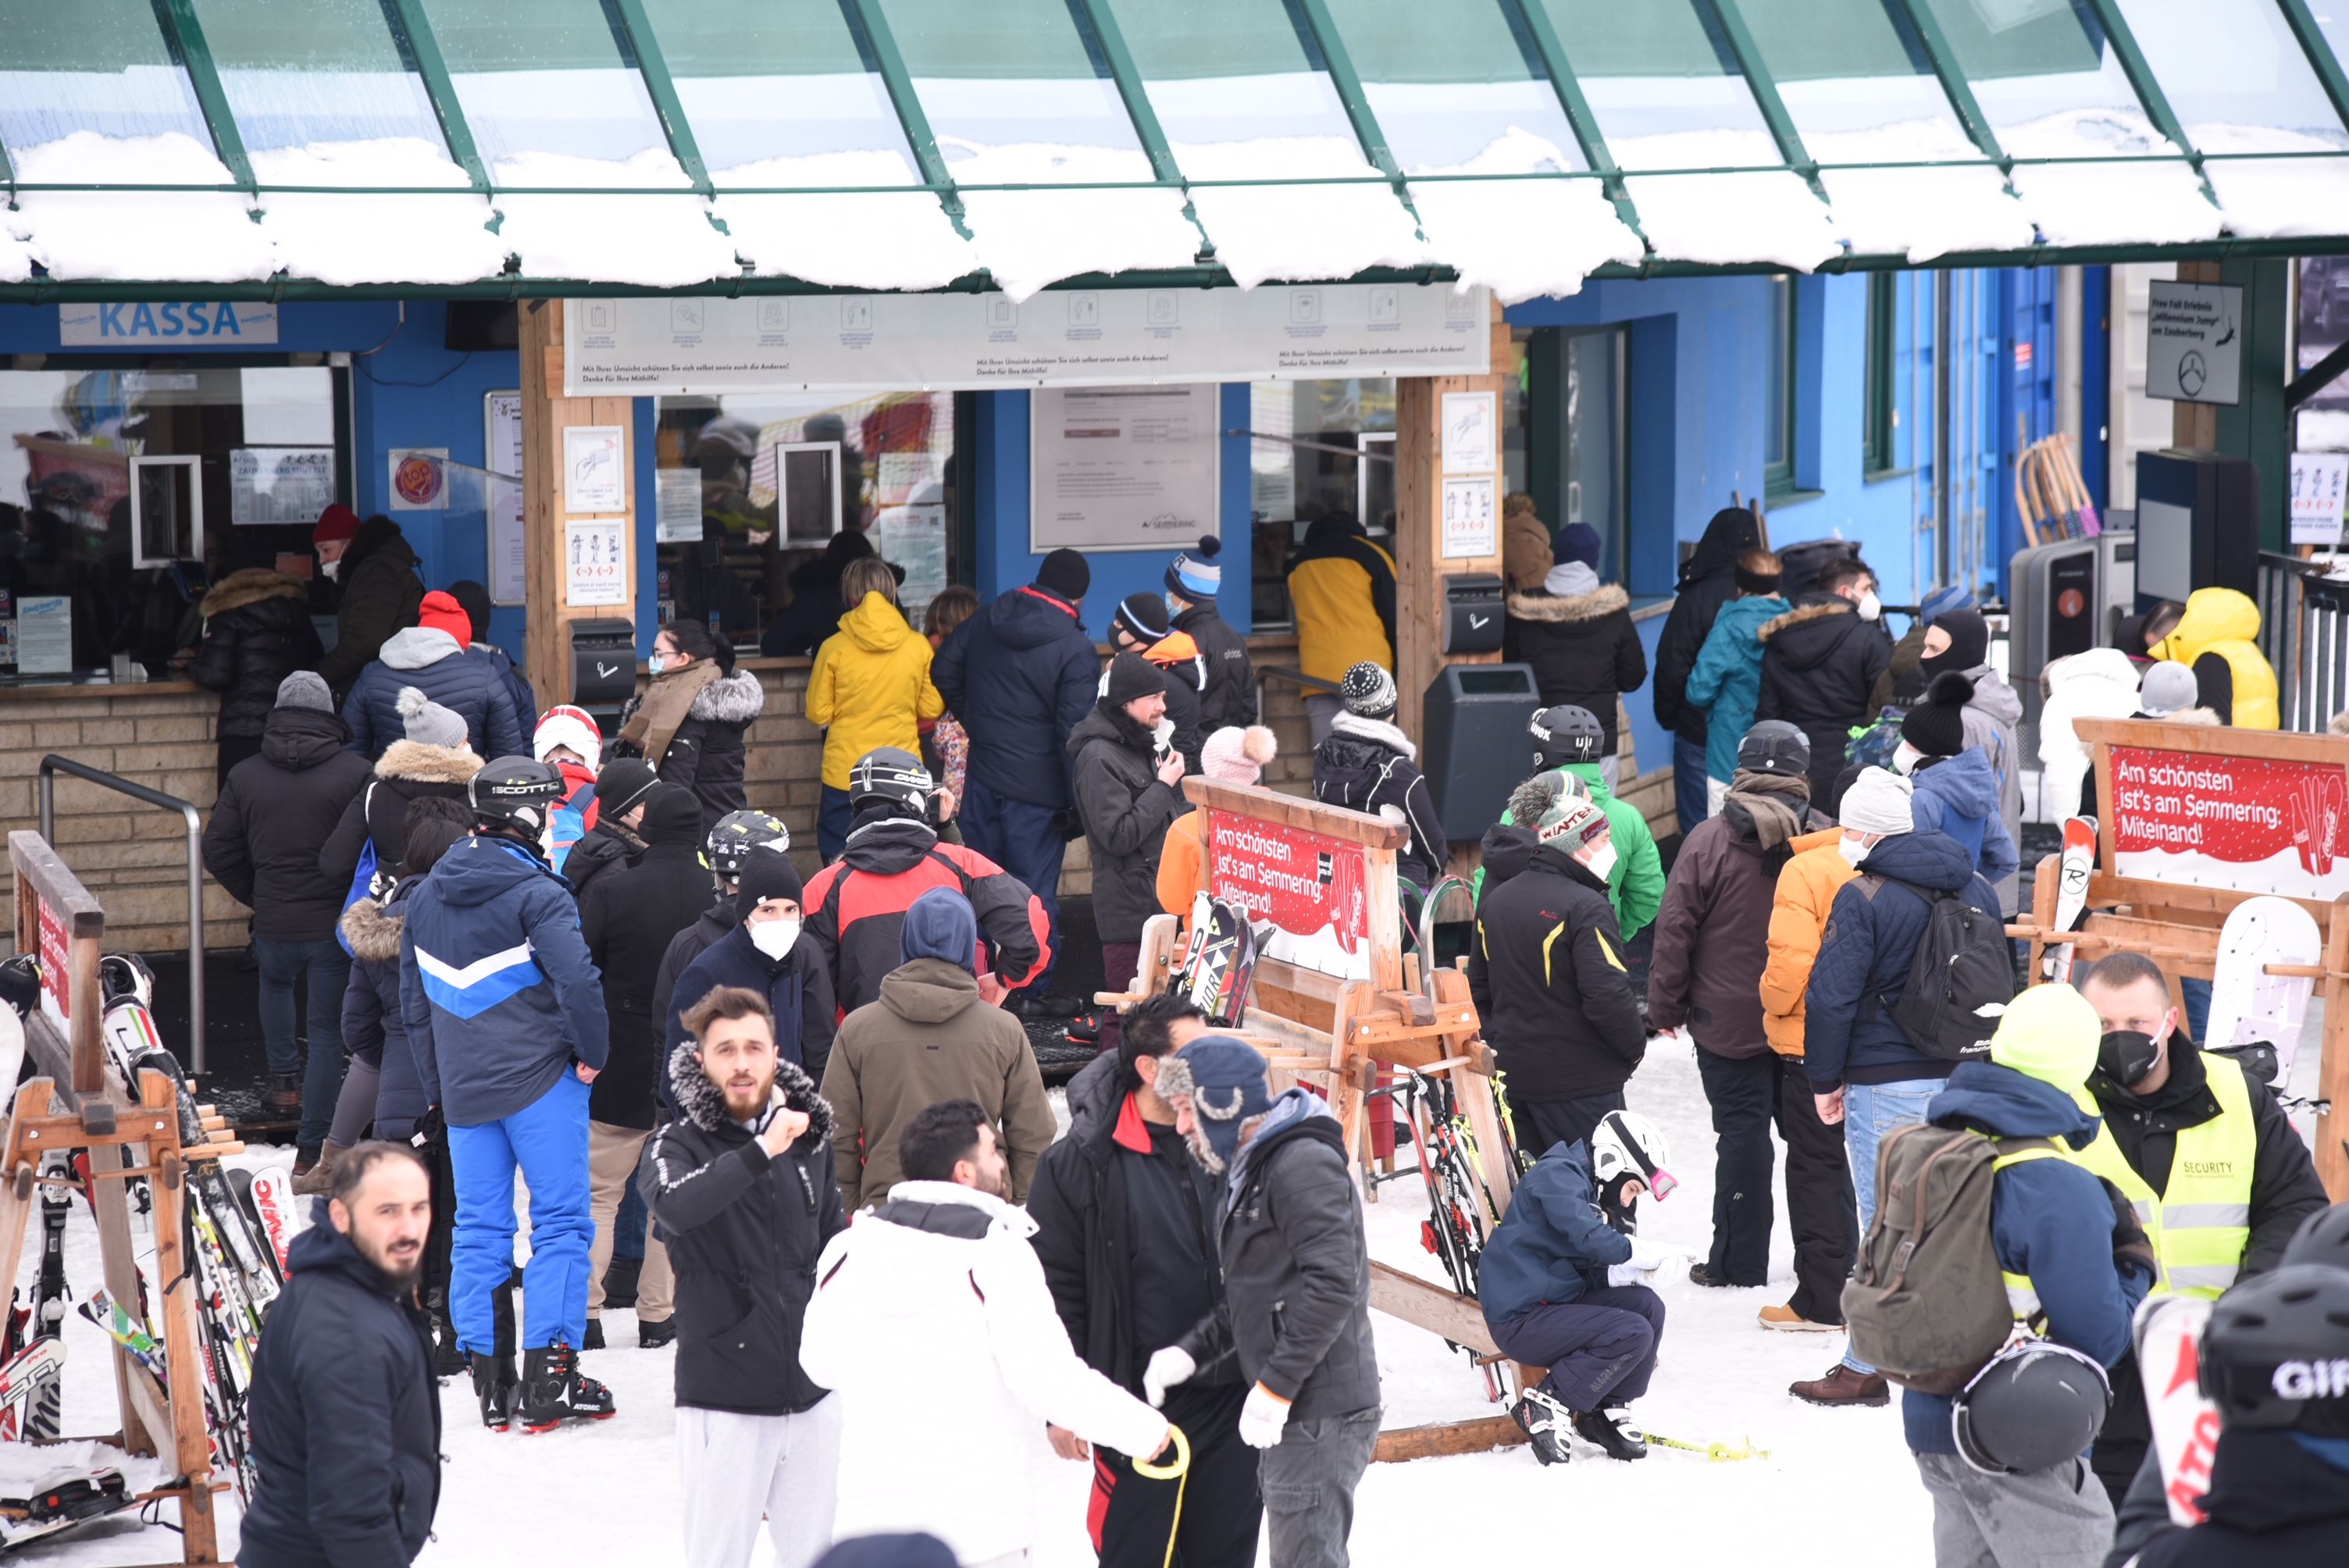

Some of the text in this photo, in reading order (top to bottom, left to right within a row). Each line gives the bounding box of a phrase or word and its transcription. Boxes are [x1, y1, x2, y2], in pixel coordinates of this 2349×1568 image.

[100, 302, 241, 337] KASSA
[2152, 298, 2212, 312] Free Fall Erlebnis
[2164, 327, 2205, 340] Zauberberg
[404, 464, 430, 483] top
[1224, 649, 1242, 660] adidas
[1530, 720, 1552, 741] uvex
[492, 784, 547, 794] SCOTT
[2119, 760, 2233, 792] Am schönsten
[1541, 806, 1596, 840] WINTER
[2155, 795, 2181, 815] am
[2185, 793, 2282, 830] Semmering:
[1216, 823, 1292, 862] Am schönsten
[2121, 814, 2205, 846] Miteinand!
[1219, 879, 1272, 914] Miteinand!
[1239, 862, 1258, 882] am
[1258, 861, 1324, 904] Semmering:
[1204, 935, 1235, 950] FISCHER
[1412, 1071, 1423, 1085] LEKI
[1499, 1099, 1508, 1114] LEKI
[1445, 1164, 1453, 1200] ALPINE
[2183, 1161, 2233, 1174] SECURITY
[1452, 1173, 1460, 1207] ALPINE
[27, 1349, 48, 1365] Pro
[203, 1343, 218, 1384] ATOMIC
[214, 1338, 228, 1381] ATOMIC
